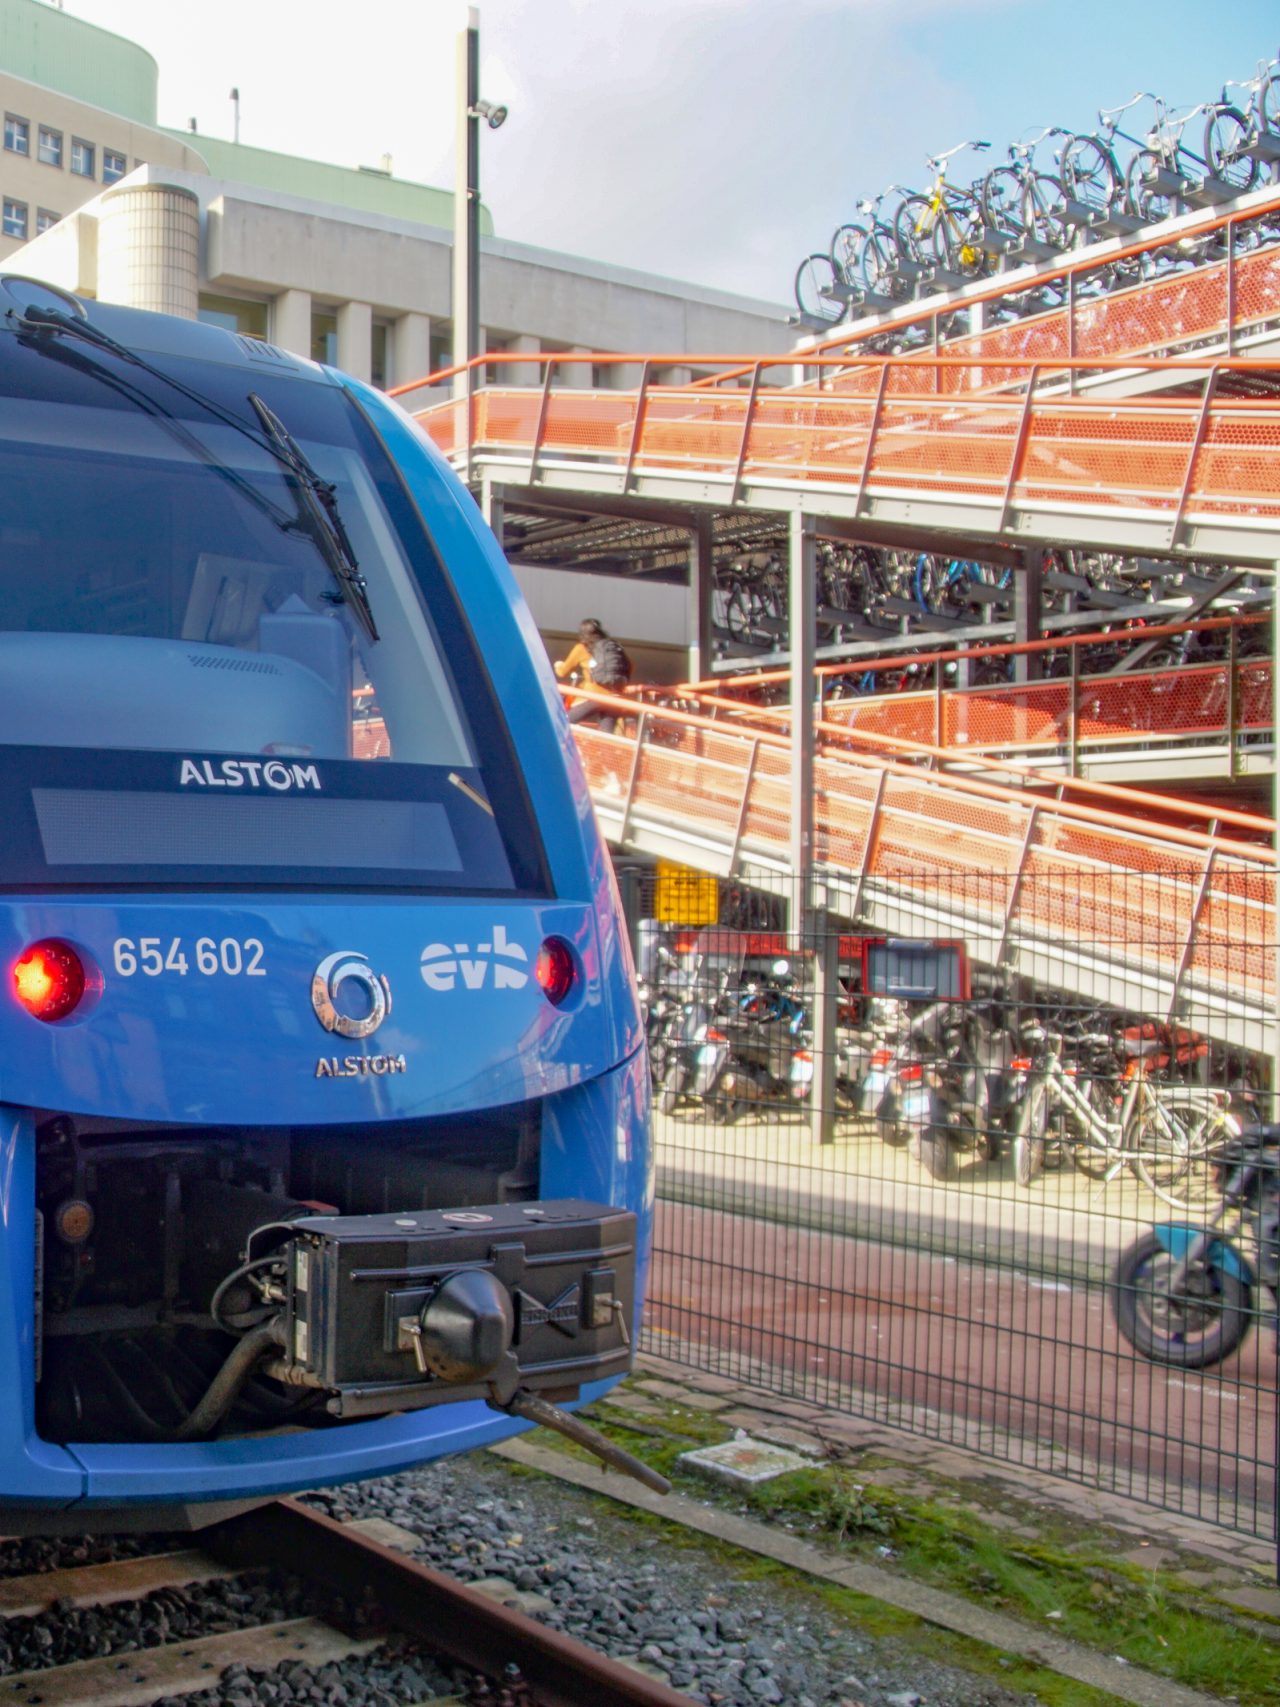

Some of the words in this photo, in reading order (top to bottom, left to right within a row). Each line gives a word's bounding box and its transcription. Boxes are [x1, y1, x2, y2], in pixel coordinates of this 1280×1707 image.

[180, 759, 322, 791] ALSTOM
[113, 937, 189, 977] 654
[195, 936, 267, 976] 602
[420, 925, 529, 992] evb
[315, 1054, 407, 1078] ALSTOM
